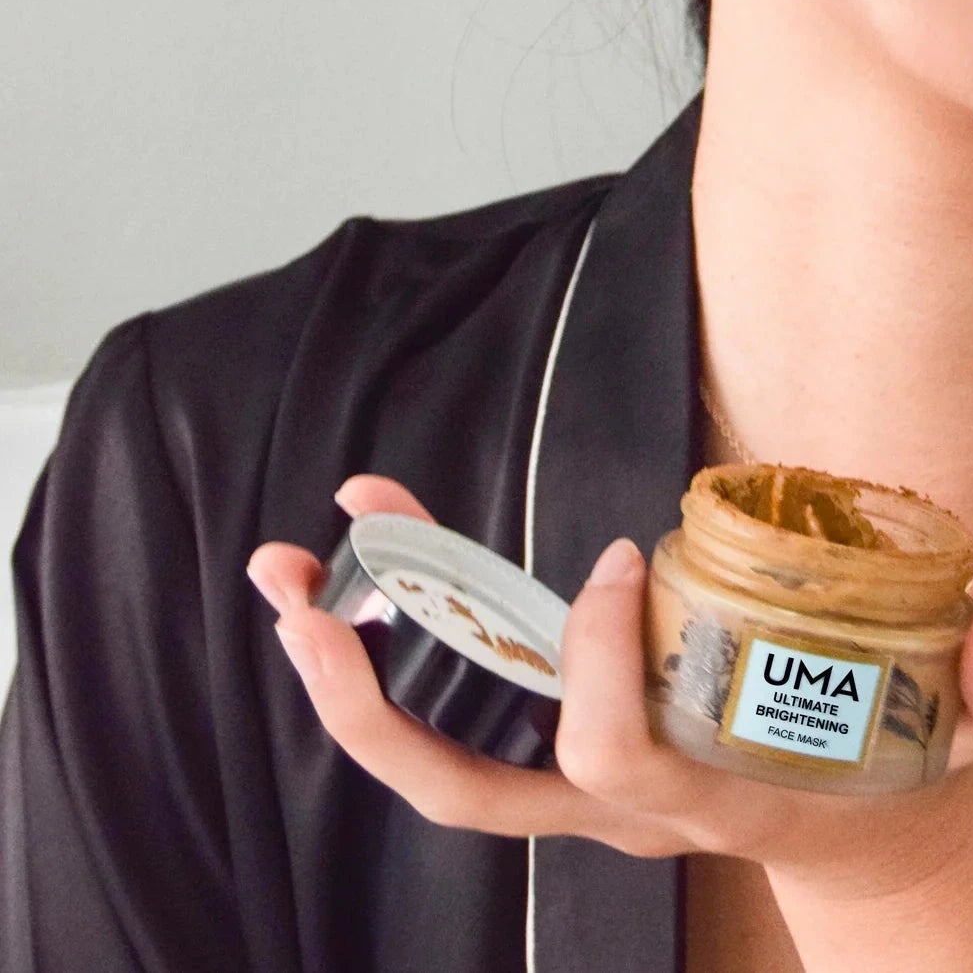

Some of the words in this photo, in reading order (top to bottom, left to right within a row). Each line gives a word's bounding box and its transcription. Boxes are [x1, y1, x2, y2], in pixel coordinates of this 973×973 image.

[763, 653, 859, 702] UMA
[773, 691, 839, 716] ULTIMATE
[755, 704, 849, 735] BRIGHTENING
[767, 726, 795, 741] FACE
[797, 732, 826, 749] MASK
